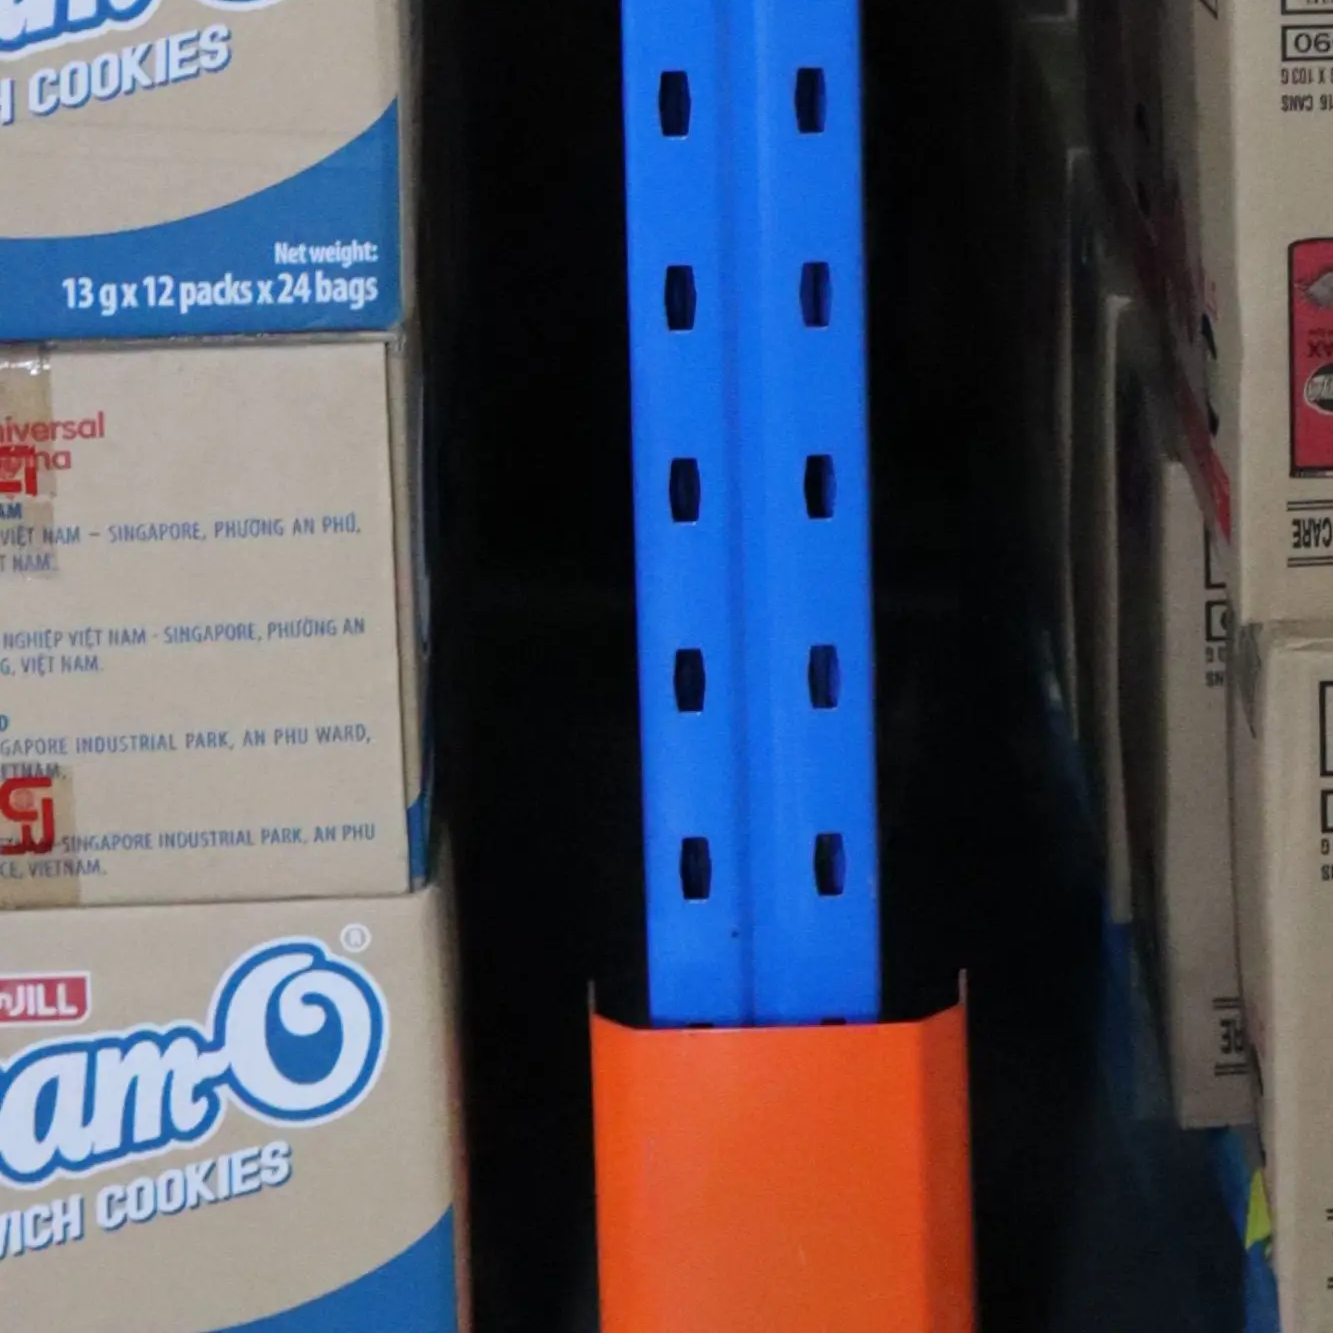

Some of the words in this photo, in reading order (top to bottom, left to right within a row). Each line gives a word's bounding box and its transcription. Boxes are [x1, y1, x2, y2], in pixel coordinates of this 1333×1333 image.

[29, 24, 231, 116] COOKIES
[275, 242, 308, 264] Net
[309, 242, 378, 265] weight:
[63, 277, 94, 310] 13
[100, 283, 116, 317] g
[143, 275, 174, 307] 12
[180, 274, 252, 313] packs
[257, 282, 272, 305] x
[279, 274, 310, 304] 24
[316, 272, 378, 311] bags
[292, 517, 314, 535] AN
[343, 619, 365, 635] AN
[77, 736, 177, 754] INDUSTRIAL
[97, 1142, 292, 1230] COOKIES
